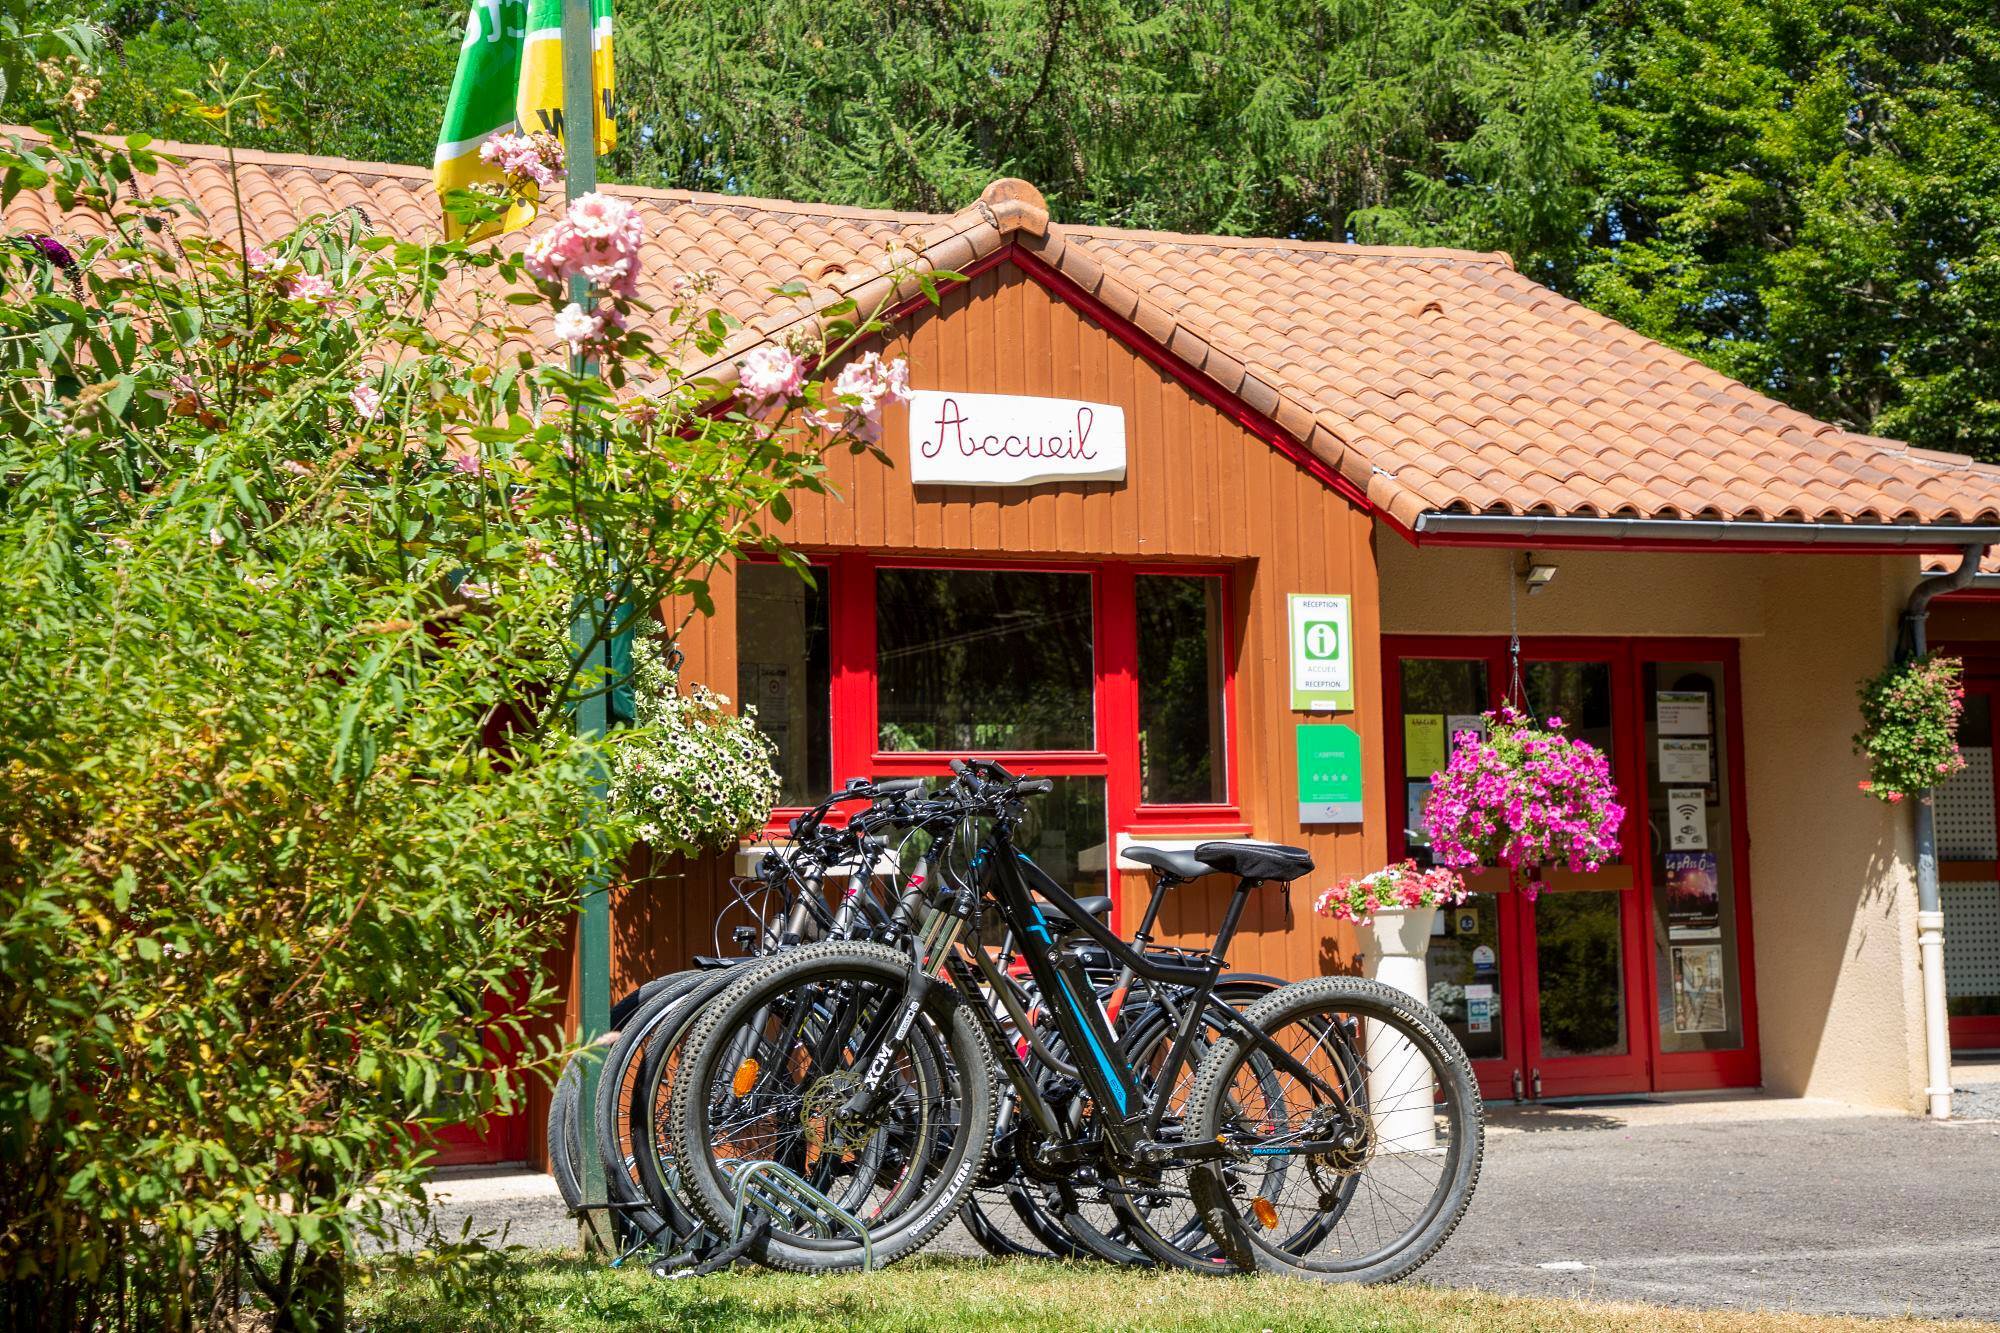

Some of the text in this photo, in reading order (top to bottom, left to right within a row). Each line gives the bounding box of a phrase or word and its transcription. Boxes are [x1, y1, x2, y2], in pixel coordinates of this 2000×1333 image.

[922, 398, 1098, 460] Accueil
[1307, 665, 1337, 673] ACCUEIL
[1305, 680, 1341, 688] RECEPTION
[864, 1043, 893, 1090] XCM
